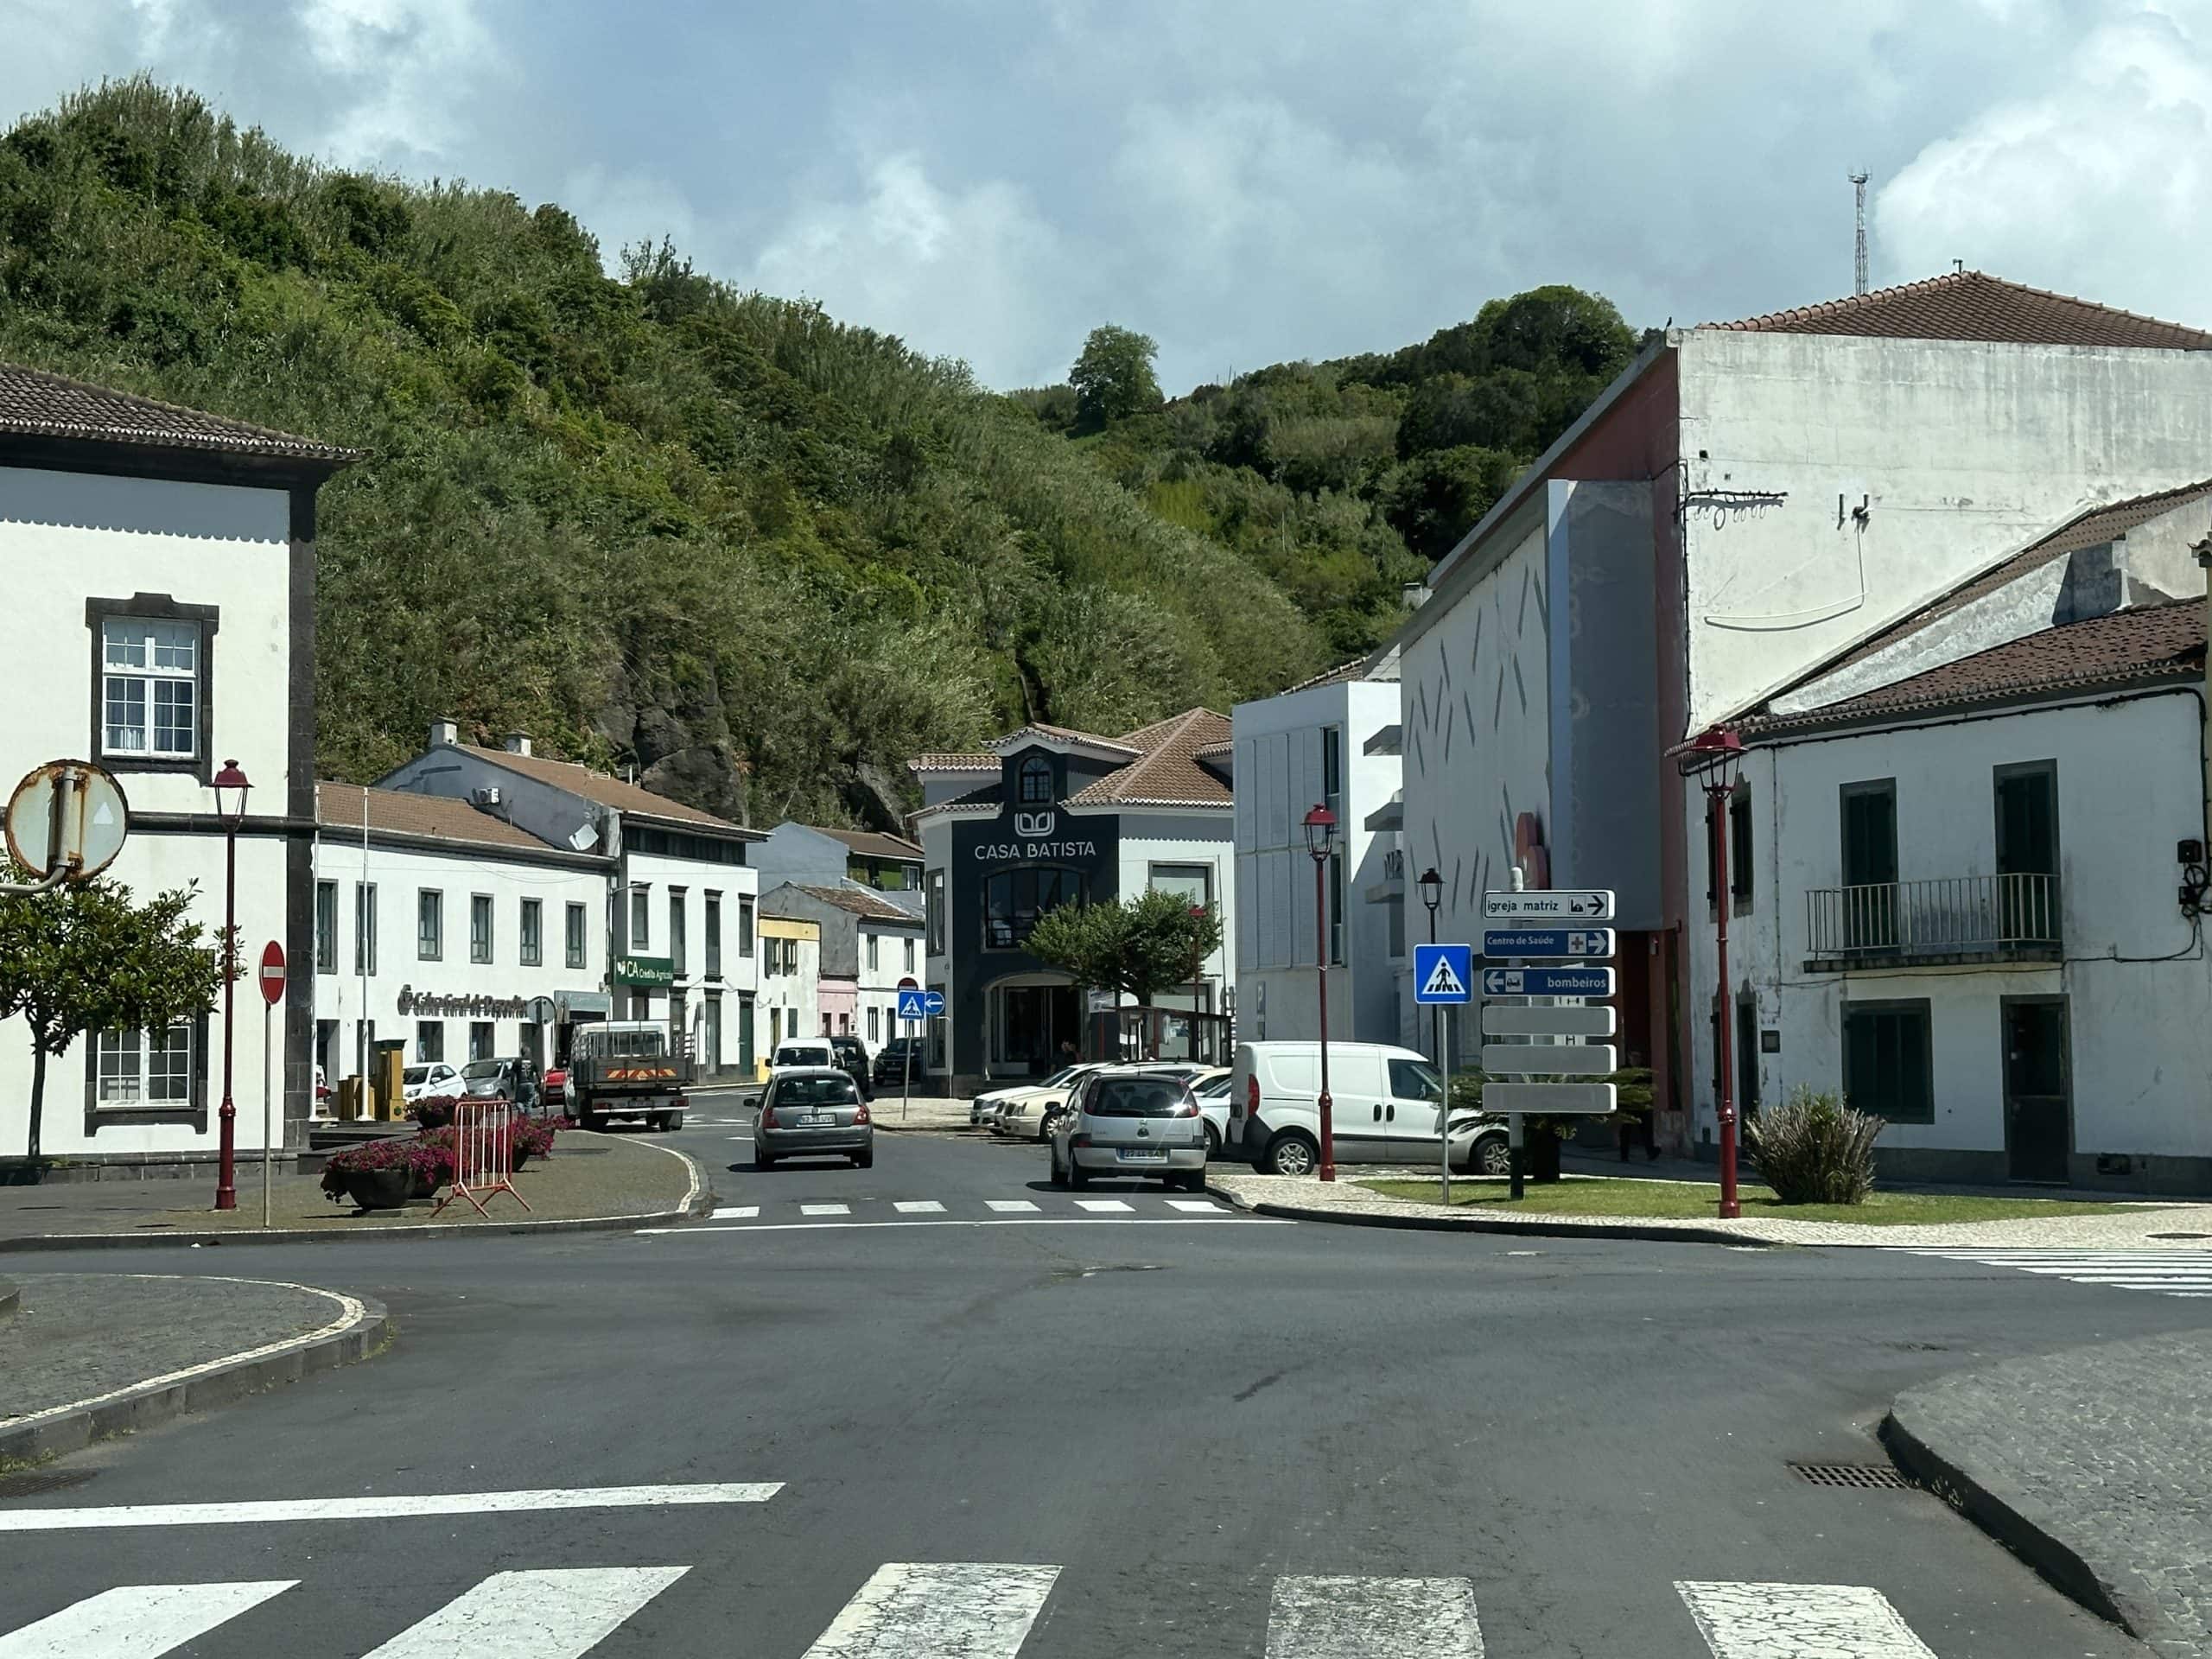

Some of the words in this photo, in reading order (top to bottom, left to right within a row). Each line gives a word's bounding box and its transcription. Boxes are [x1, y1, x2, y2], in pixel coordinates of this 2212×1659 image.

[974, 843, 1020, 860] CASA
[1027, 841, 1096, 858] BATISTA
[1487, 899, 1517, 912] igreja
[1523, 899, 1559, 911] matriz
[1487, 936, 1515, 945] Centro
[1516, 936, 1527, 945] de
[1528, 936, 1554, 945] Saúde
[626, 960, 639, 978] CA
[1548, 976, 1606, 988] bombeiros
